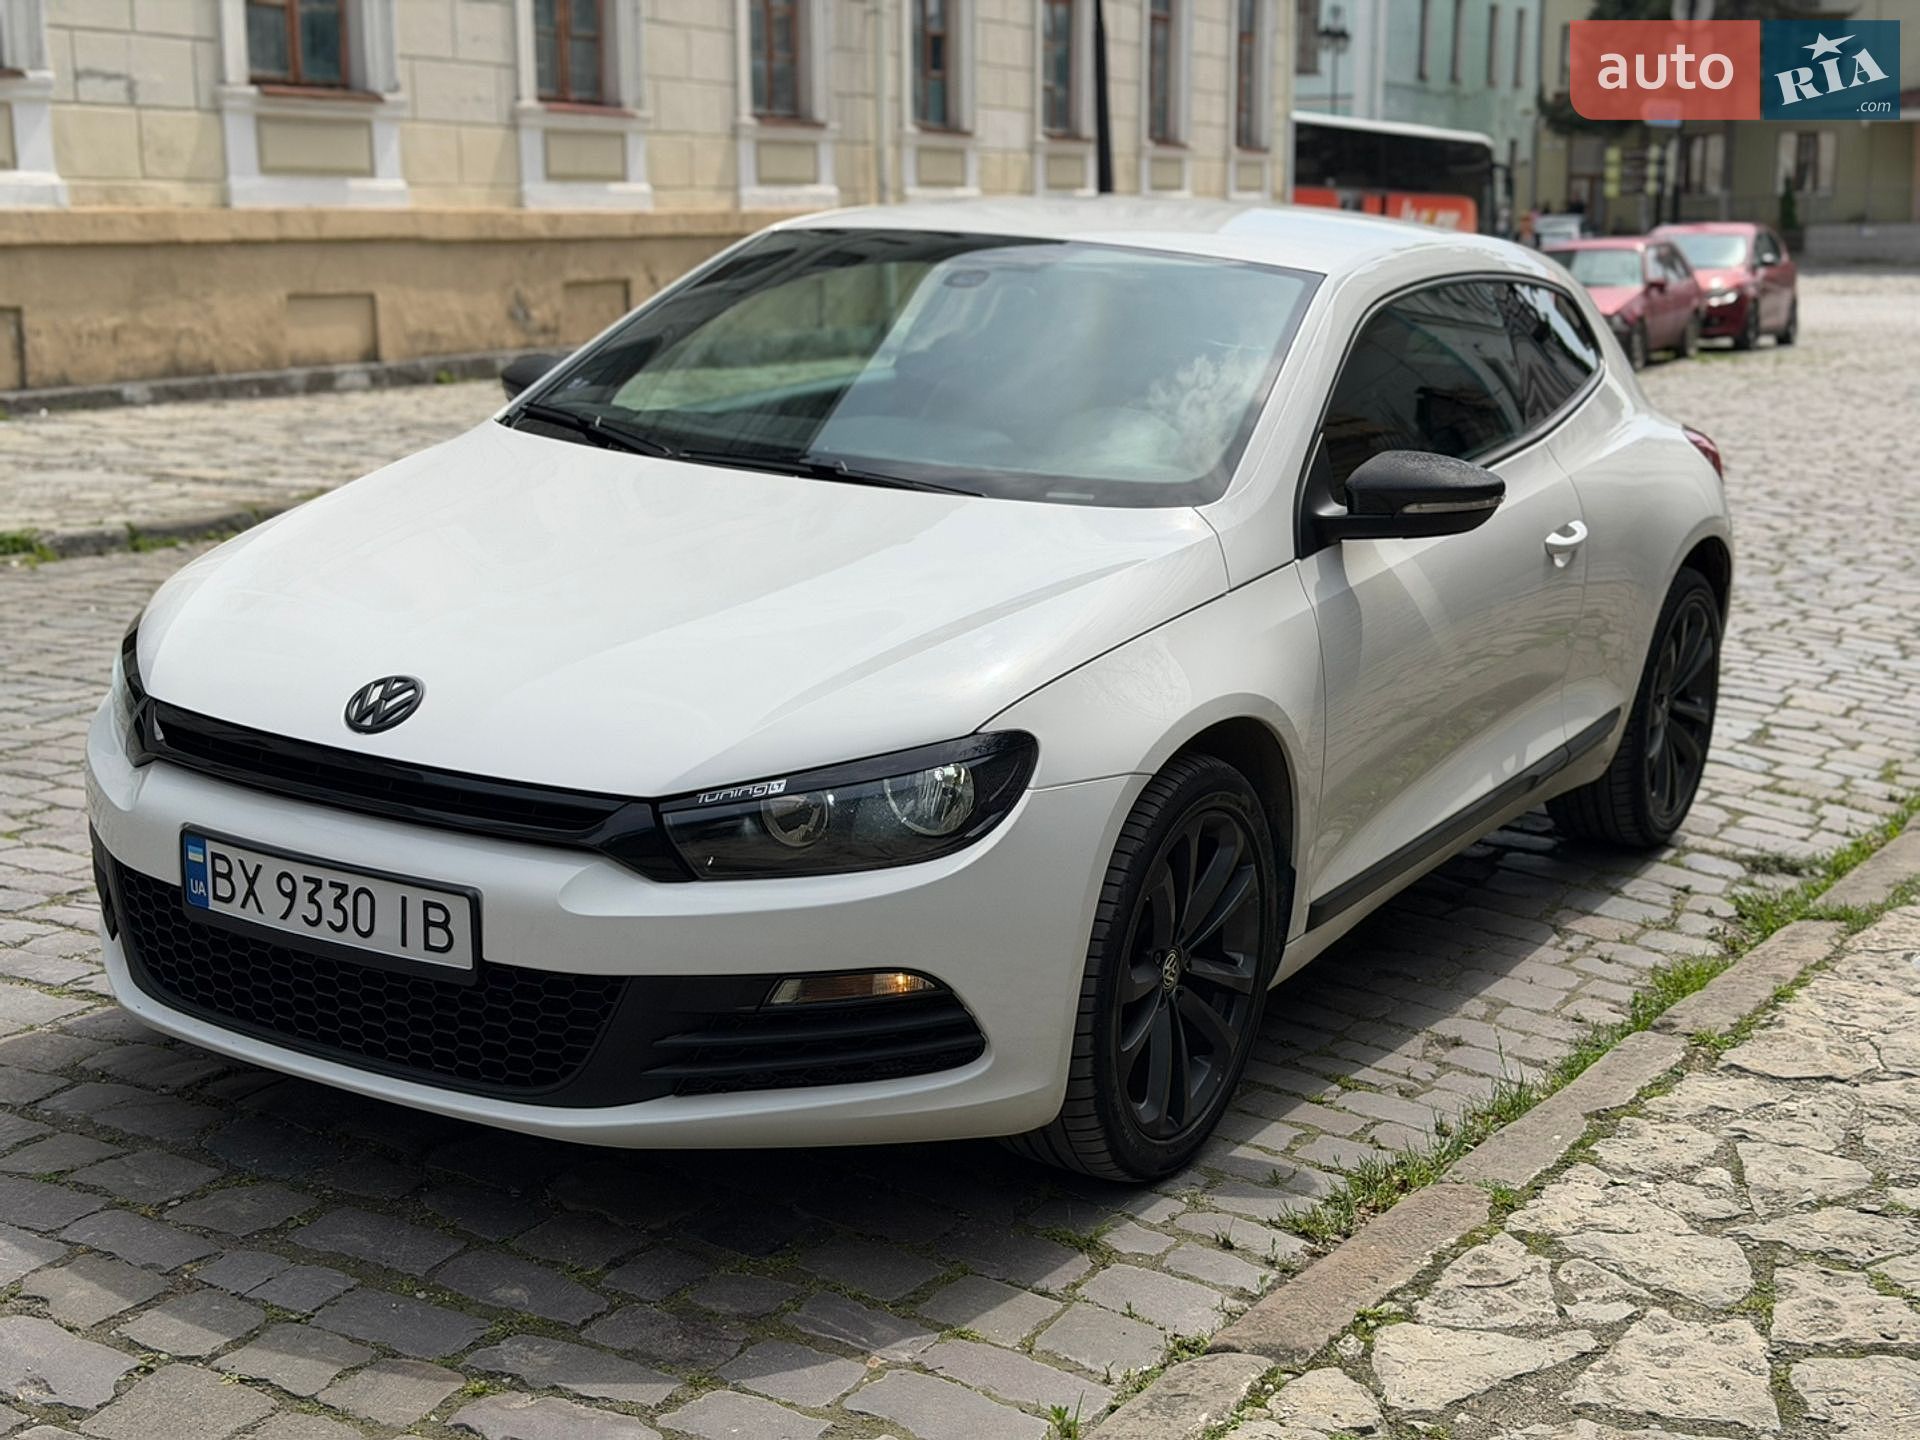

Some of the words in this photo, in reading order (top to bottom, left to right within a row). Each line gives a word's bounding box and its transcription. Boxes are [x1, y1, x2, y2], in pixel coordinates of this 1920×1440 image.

[190, 878, 207, 897] UA
[211, 851, 264, 914] BX
[276, 871, 375, 938] 9330
[401, 895, 454, 953] IB
